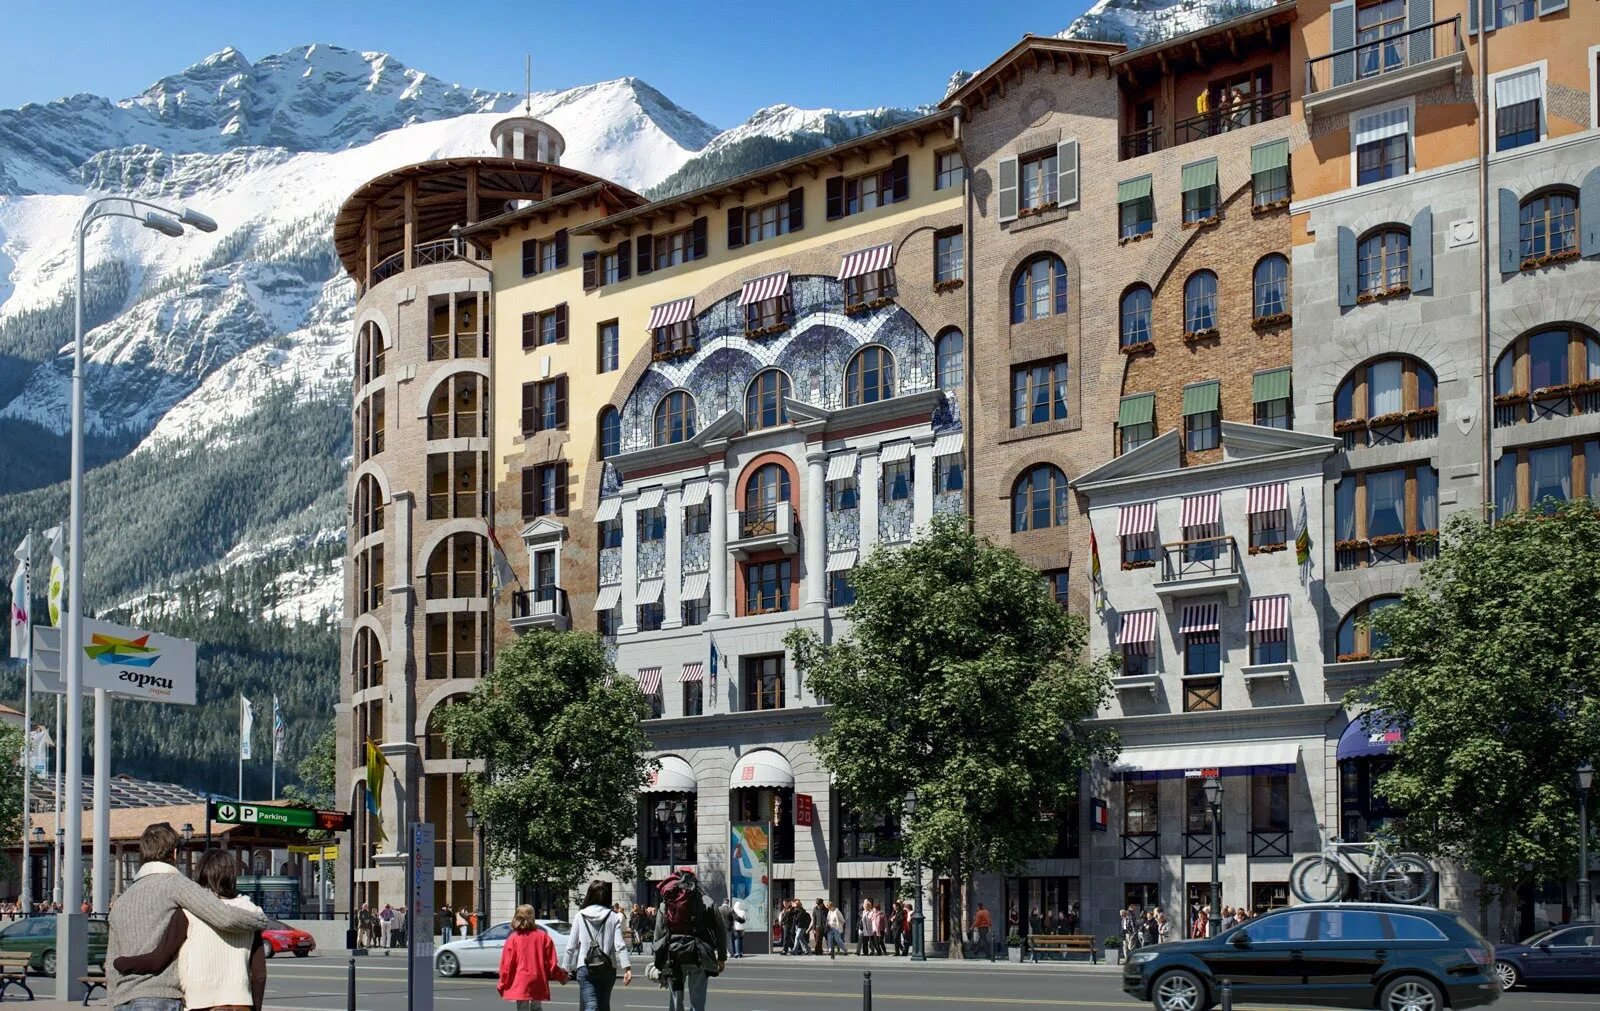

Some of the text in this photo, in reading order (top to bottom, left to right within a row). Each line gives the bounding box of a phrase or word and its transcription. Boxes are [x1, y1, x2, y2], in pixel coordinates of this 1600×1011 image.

[119, 671, 173, 689] горки
[244, 808, 288, 822] P Parking
